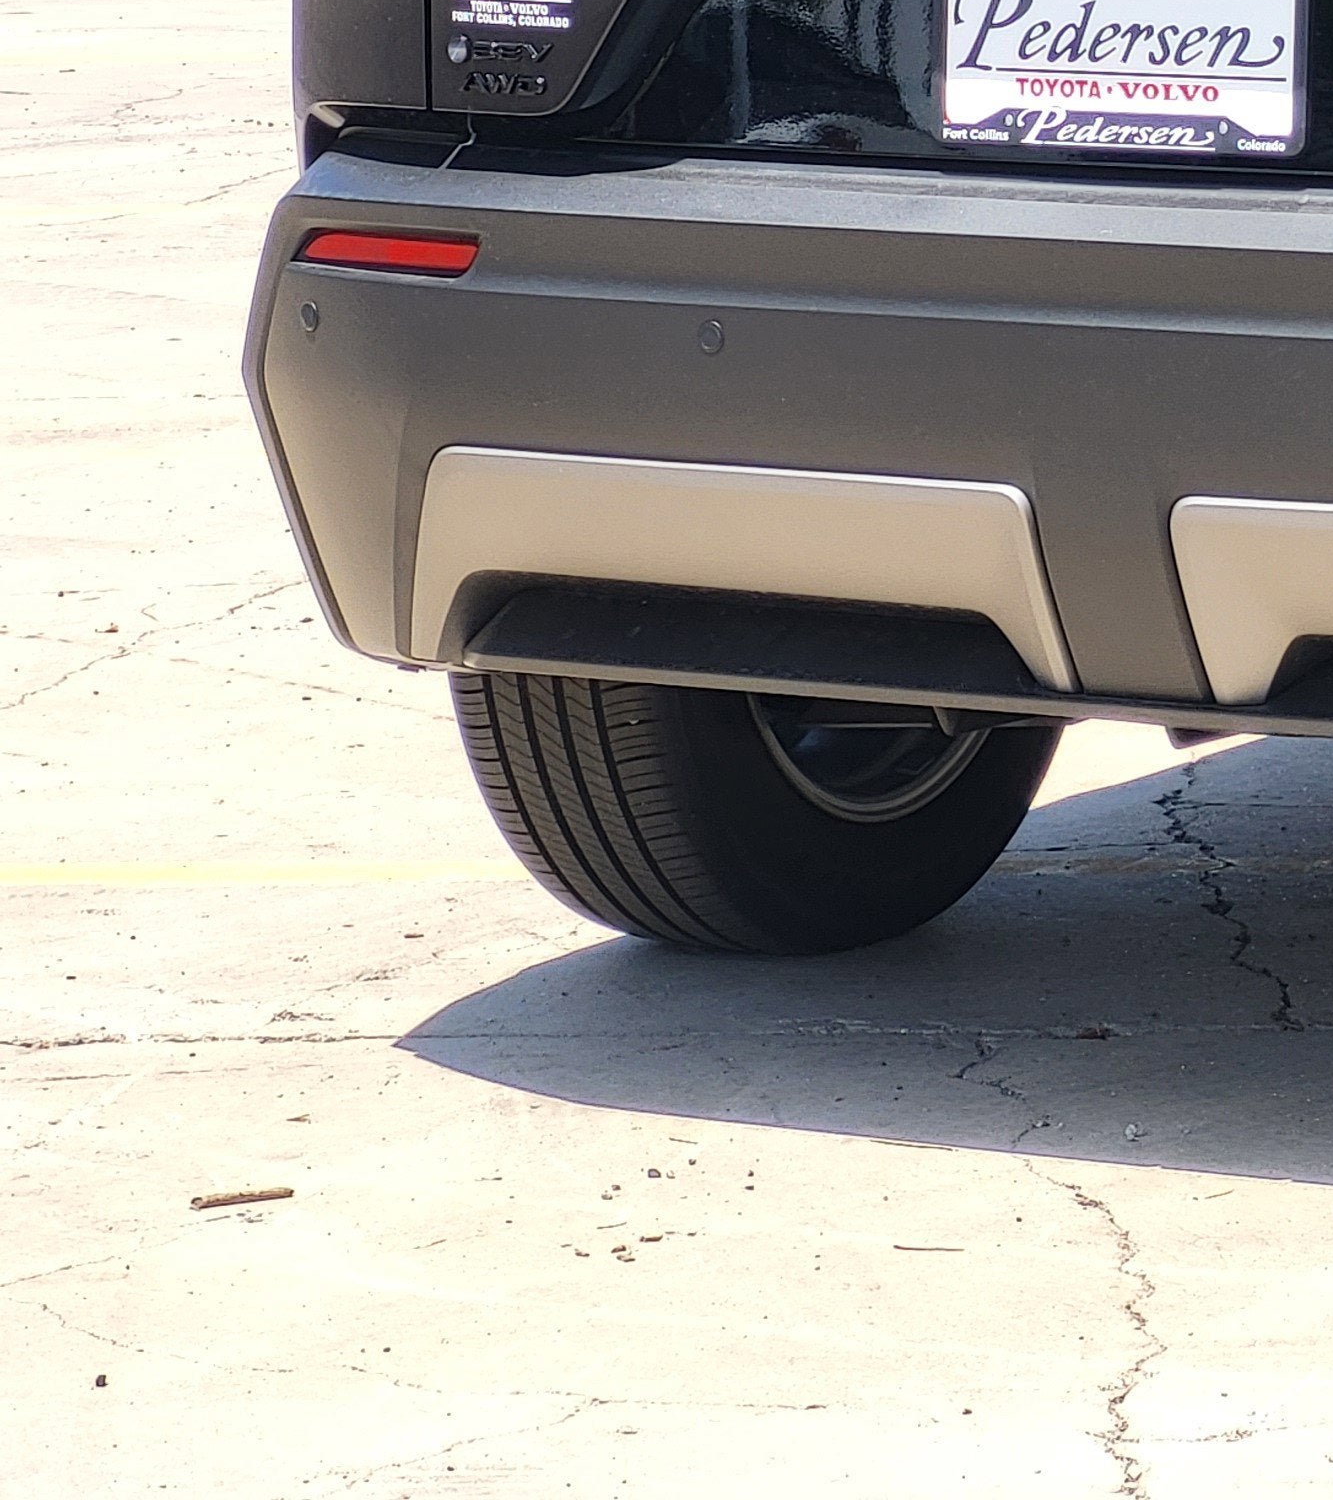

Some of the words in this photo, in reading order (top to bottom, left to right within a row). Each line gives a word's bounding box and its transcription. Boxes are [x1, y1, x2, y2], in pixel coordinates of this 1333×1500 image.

[470, 1, 502, 13] TOYOTA
[510, 3, 549, 15] VOLVO
[452, 11, 474, 23] FORT
[461, 72, 547, 96] AWD
[1016, 77, 1101, 100] TOYOTA
[1118, 82, 1220, 102] VOLVO
[942, 127, 967, 141] Fort
[969, 128, 1009, 142] Collins
[1017, 106, 1215, 151] Pedersen
[1237, 139, 1286, 153] Colorado
